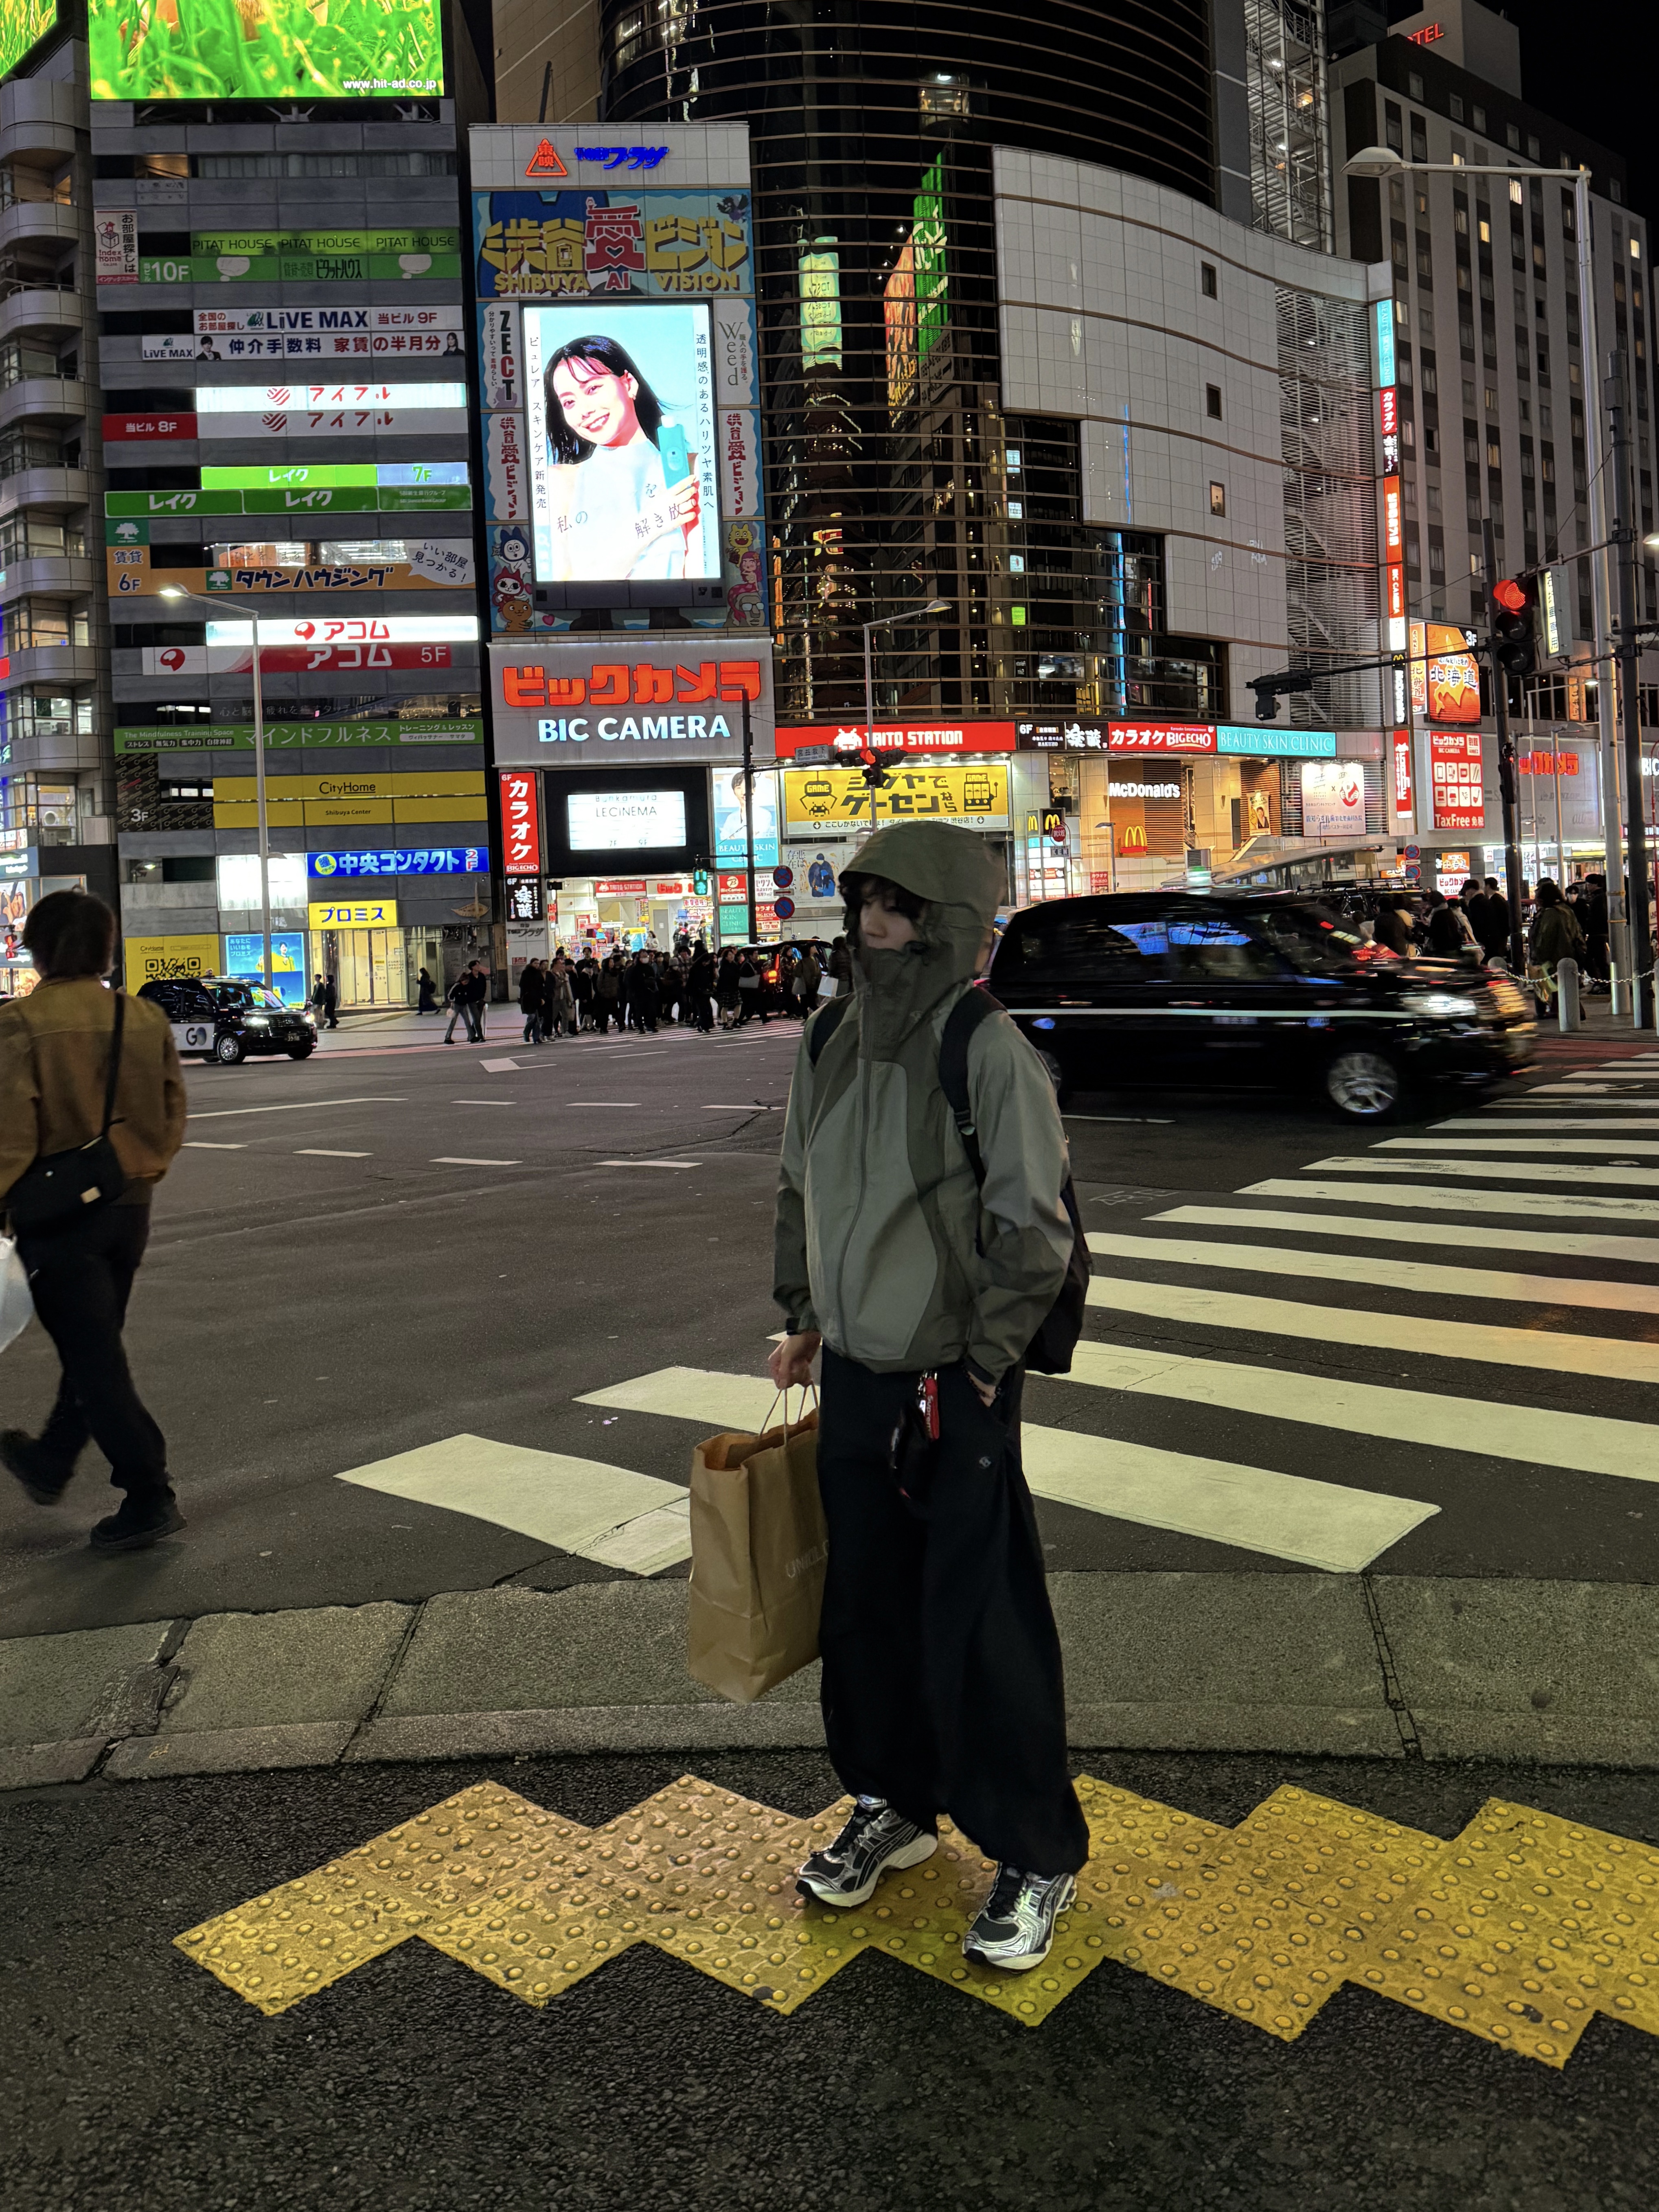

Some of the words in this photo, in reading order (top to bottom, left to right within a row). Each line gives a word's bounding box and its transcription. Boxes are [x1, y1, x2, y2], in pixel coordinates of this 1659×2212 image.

[343, 78, 436, 90] www.hit-ad.co.jp
[122, 214, 136, 273] お部屋探しは
[193, 240, 225, 250] PITAT
[229, 239, 272, 248] HOUSE
[281, 239, 313, 248] PITAT
[317, 238, 360, 248] HOUSE
[377, 237, 408, 247] PITAT
[412, 236, 455, 246] HOUSE
[151, 261, 189, 281] 10F
[494, 273, 592, 293] SHIBUYA
[606, 271, 631, 290] AI
[653, 271, 740, 293] VISION
[198, 313, 226, 321] 全国の
[319, 311, 369, 328] MAX
[378, 313, 414, 324] 当ビル
[418, 312, 437, 323] 9F
[199, 322, 244, 331] お部屋探し
[229, 338, 321, 354] 仲介手数料
[334, 335, 441, 353] 家賃の半月分
[169, 349, 193, 358] MAX
[500, 311, 515, 401] ZECT
[717, 321, 744, 386] Weed
[309, 386, 390, 402] アイフル
[307, 411, 394, 428] アイフル
[1383, 391, 1395, 432] カラオケ
[125, 423, 155, 432] 当ビル
[158, 421, 177, 432] 8F
[532, 401, 548, 509] スキンケア新発売
[269, 469, 309, 482] レイク
[412, 466, 432, 482] 7F
[149, 493, 197, 510] レイク
[285, 490, 332, 507] レイク
[114, 550, 142, 565] 賃貸
[423, 542, 468, 570] いい部屋
[118, 573, 141, 592] 6F
[235, 566, 394, 589] タウンハウジング
[324, 620, 390, 641] アコム
[1466, 630, 1477, 646] 3F
[307, 644, 392, 669] アコム
[421, 646, 447, 662] 5F
[503, 660, 761, 707] ビックカメラ
[1411, 666, 1425, 700] 北海道
[1430, 666, 1478, 689] 北海道
[243, 727, 391, 745] マインドフルネス
[538, 718, 590, 743] BIC
[597, 715, 731, 741] CAMERA
[1019, 724, 1033, 734] 6F
[1111, 729, 1166, 745] カラオケ
[864, 731, 903, 747] TAITO
[907, 730, 963, 746] STATION
[1221, 731, 1260, 749] BEAUTY
[1263, 734, 1288, 750] SKIN
[1291, 736, 1333, 752] CLINIC
[1433, 735, 1465, 746] ビックカメラ
[501, 774, 512, 782] 6F
[966, 774, 987, 782] GAME
[319, 782, 376, 794] CityHome
[806, 784, 830, 793] GAME
[1109, 782, 1181, 798] McDonald's
[596, 794, 657, 802] Bunkamura
[131, 809, 148, 822] 3F
[508, 779, 533, 861] カラオケ
[1435, 813, 1470, 827] TaxFree
[719, 844, 746, 852] BEAUT
[755, 843, 776, 851] SKIN
[339, 851, 459, 874] 中央コンタクト
[465, 849, 479, 871] 2F
[319, 907, 386, 923] プロミス
